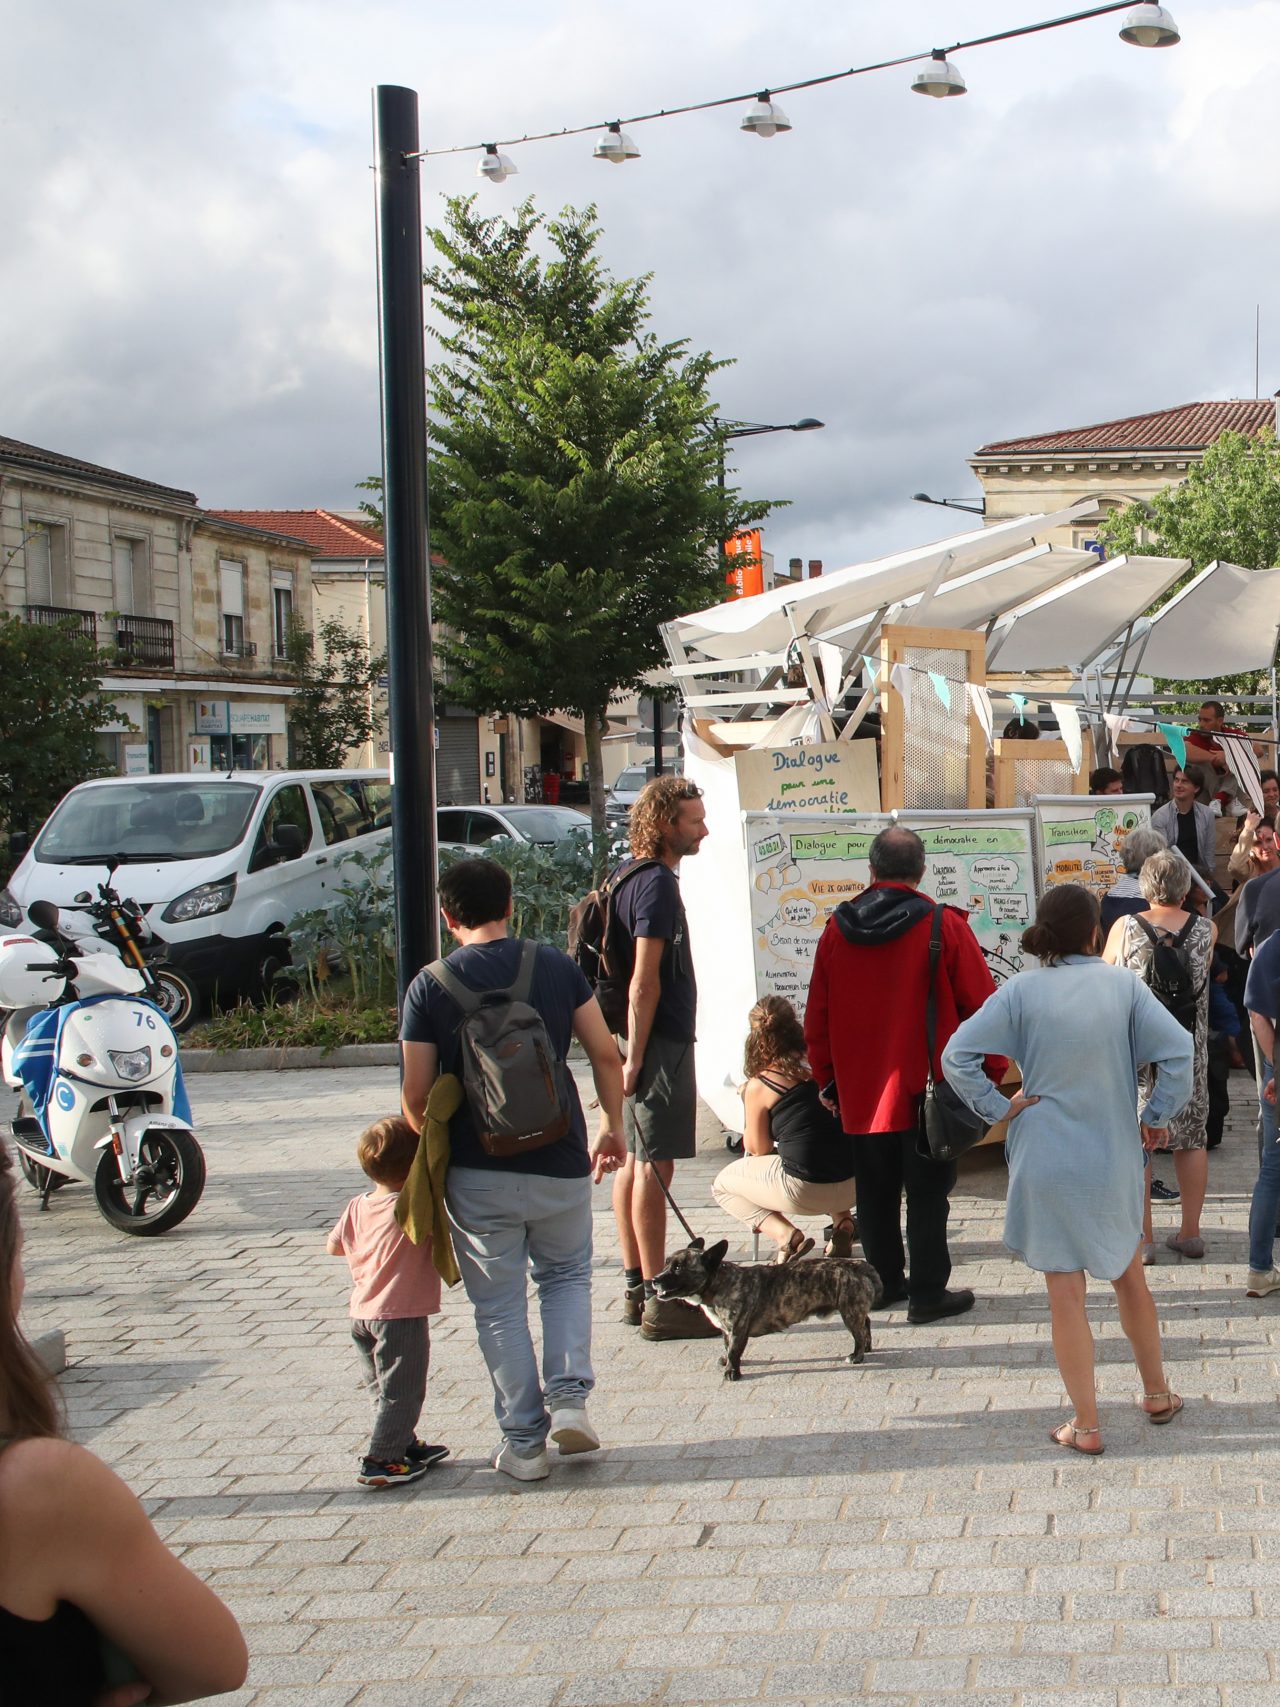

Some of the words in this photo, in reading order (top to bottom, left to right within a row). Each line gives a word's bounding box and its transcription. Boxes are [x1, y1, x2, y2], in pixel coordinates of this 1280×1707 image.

[772, 750, 841, 772] Dialogue
[781, 781, 806, 796] pour
[811, 778, 836, 787] une
[1048, 826, 1089, 837] Transition
[933, 835, 978, 845] démocratie
[795, 839, 837, 855] Dialogue
[847, 841, 867, 854] pour
[811, 883, 825, 894] VIE
[794, 936, 800, 945] de
[795, 947, 810, 957] #1
[132, 1011, 156, 1030] 76
